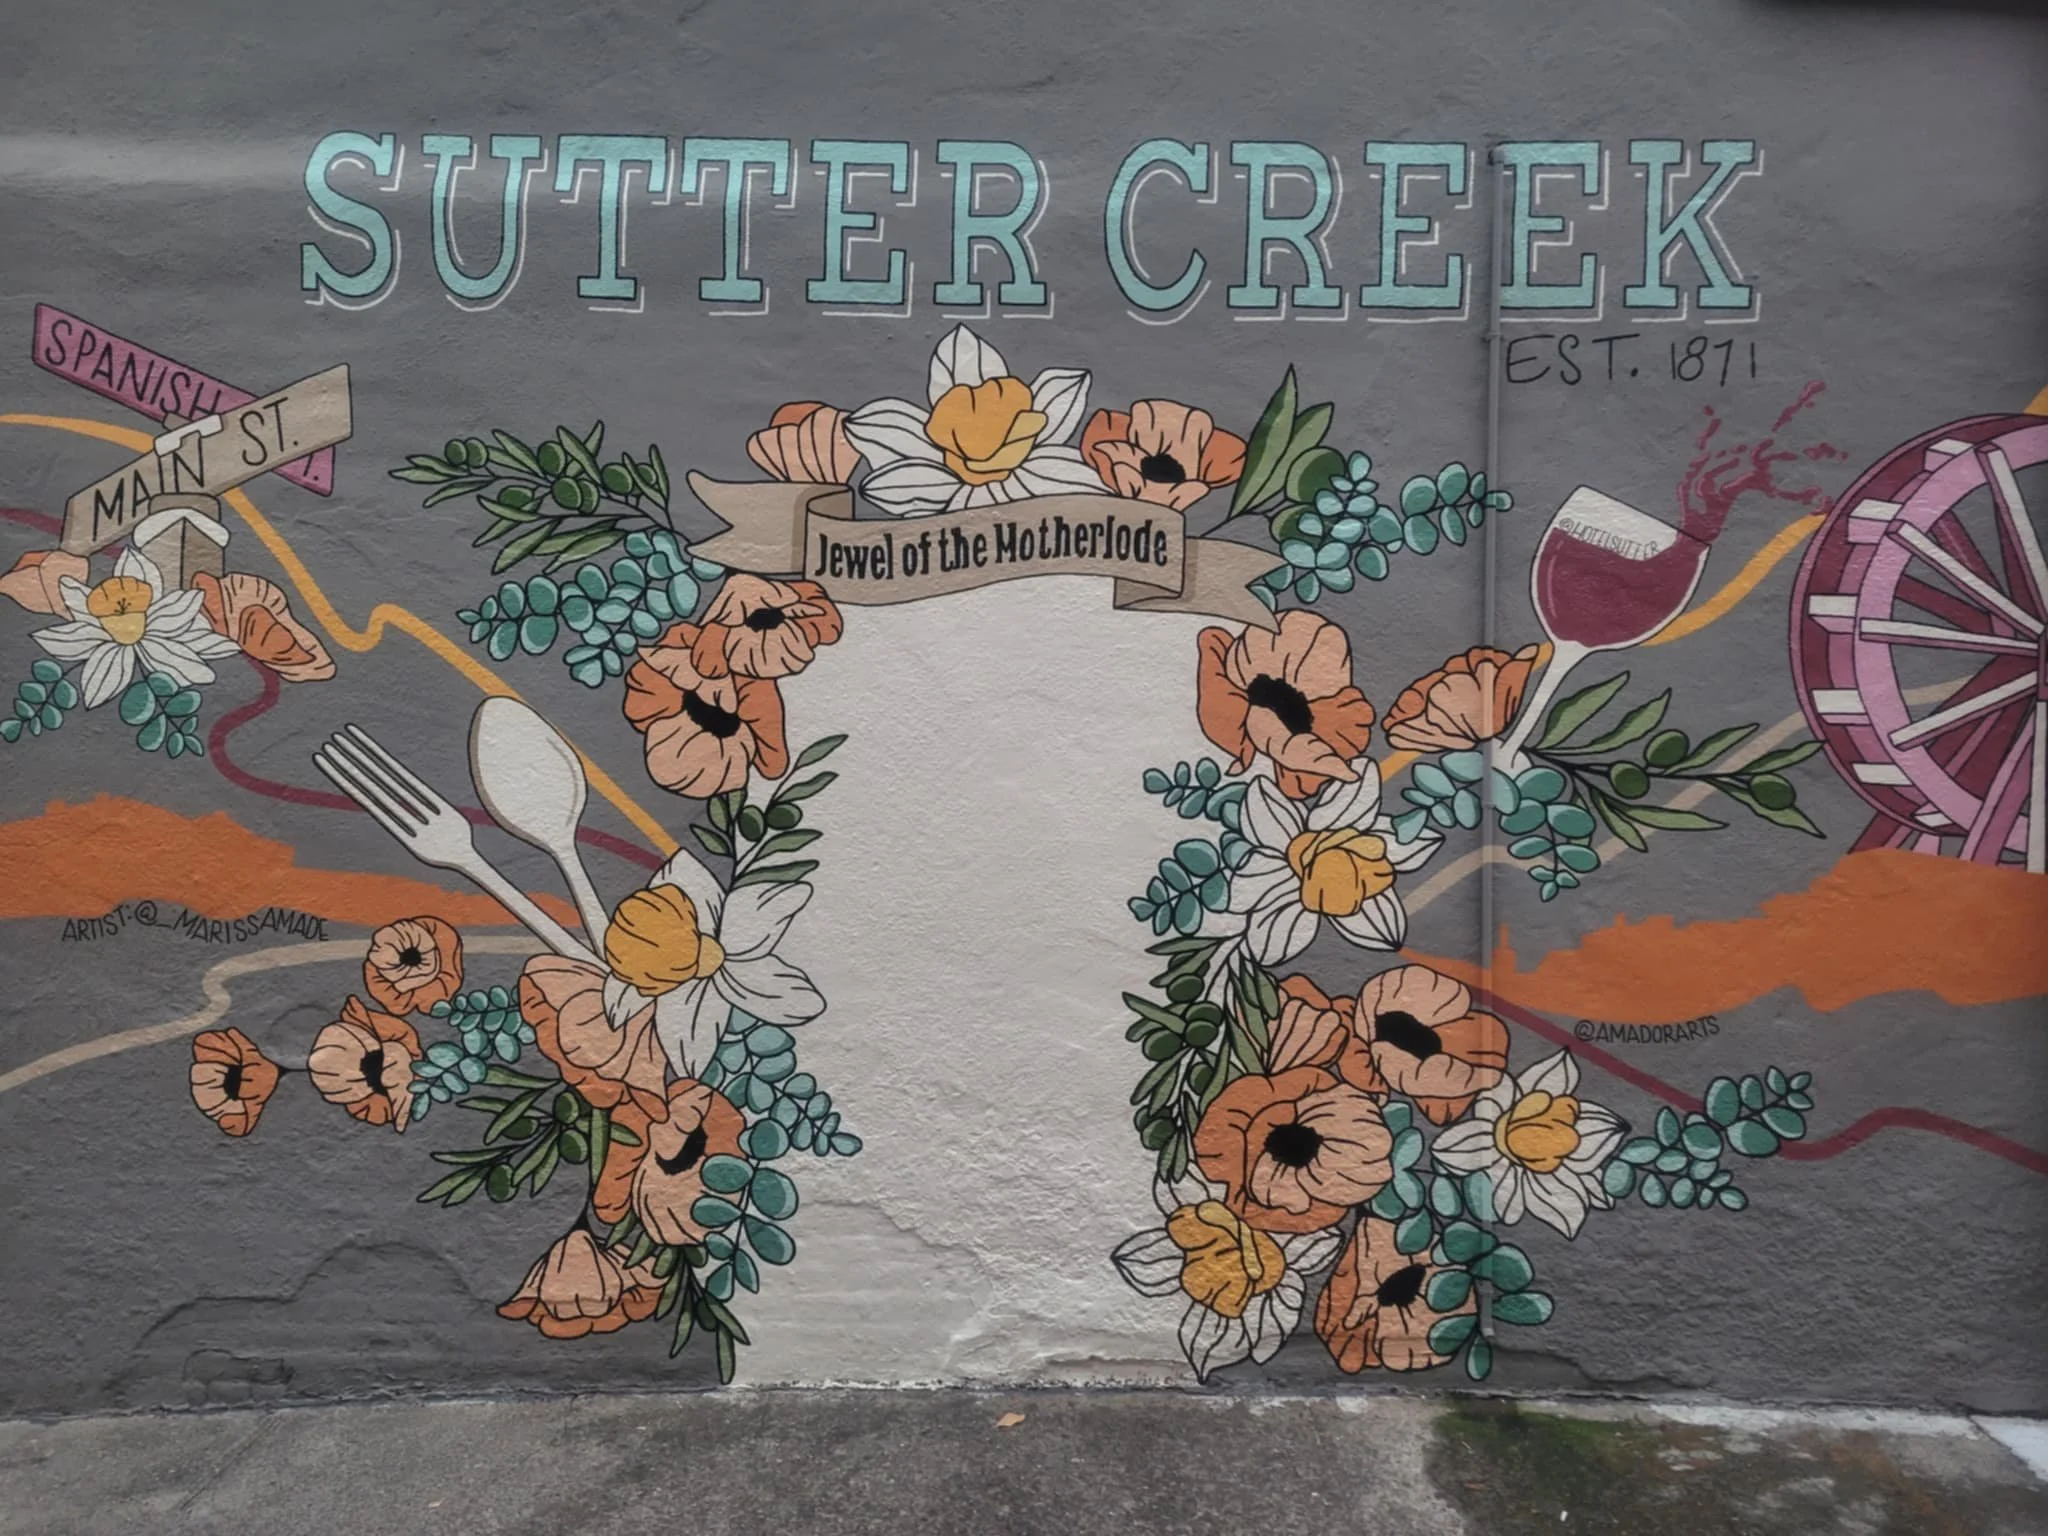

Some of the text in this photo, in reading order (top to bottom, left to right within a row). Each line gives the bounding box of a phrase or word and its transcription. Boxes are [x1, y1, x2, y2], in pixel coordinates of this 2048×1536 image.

[300, 129, 1764, 324] SUTTER CREEK
[44, 318, 222, 420] SPANISH
[1505, 332, 1757, 388] EST. 1871
[92, 396, 299, 542] MAIN ST.
[814, 514, 1169, 581] Jewel of the Motherlode
[61, 903, 133, 943] ARTIST:
[1574, 1014, 1721, 1045] @AMADORARTS
